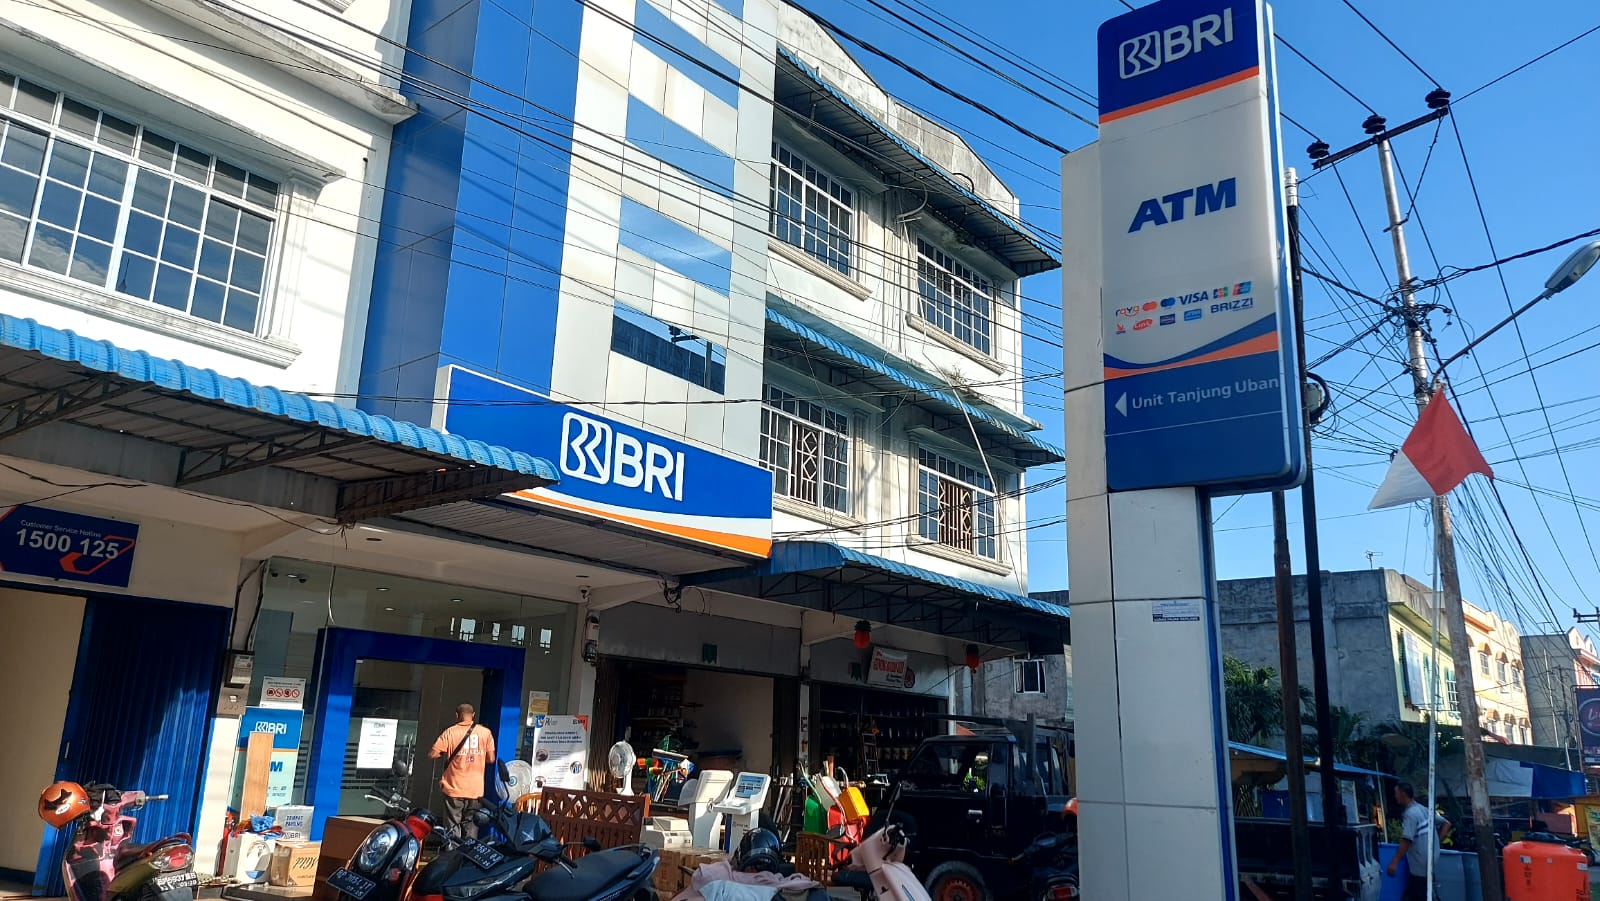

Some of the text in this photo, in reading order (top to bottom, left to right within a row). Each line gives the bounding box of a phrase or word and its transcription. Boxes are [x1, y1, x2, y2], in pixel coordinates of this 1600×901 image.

[1163, 7, 1234, 64] BRI
[1127, 177, 1237, 234] ATM
[1177, 290, 1209, 306] VISA
[1210, 297, 1254, 314] BRIZZI
[1132, 378, 1279, 409] Unit Tanjung Uban
[613, 432, 685, 502] BRI
[16, 528, 119, 560] 1500 125
[268, 722, 288, 735] BRI
